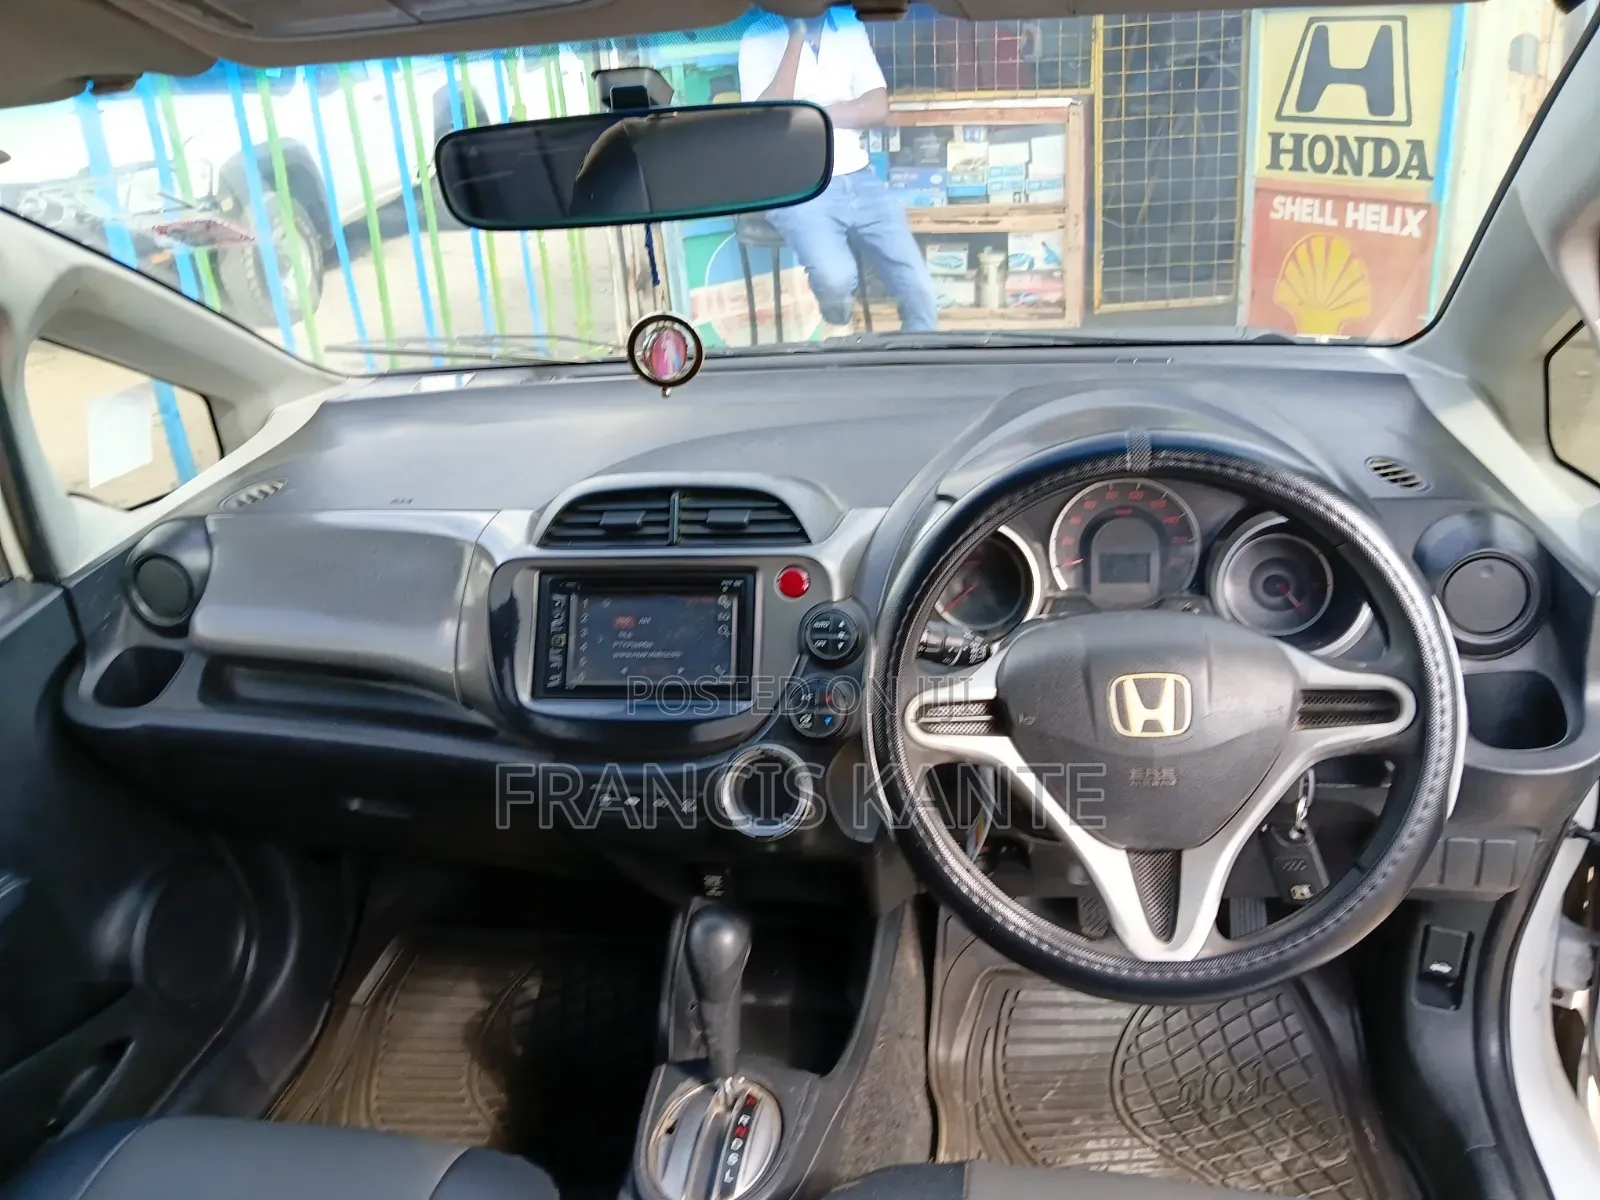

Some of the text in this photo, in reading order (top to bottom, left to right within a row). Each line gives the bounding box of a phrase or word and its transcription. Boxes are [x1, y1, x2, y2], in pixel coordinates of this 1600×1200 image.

[1265, 131, 1434, 182] HONDA
[1269, 195, 1428, 238] SHELL HELIX
